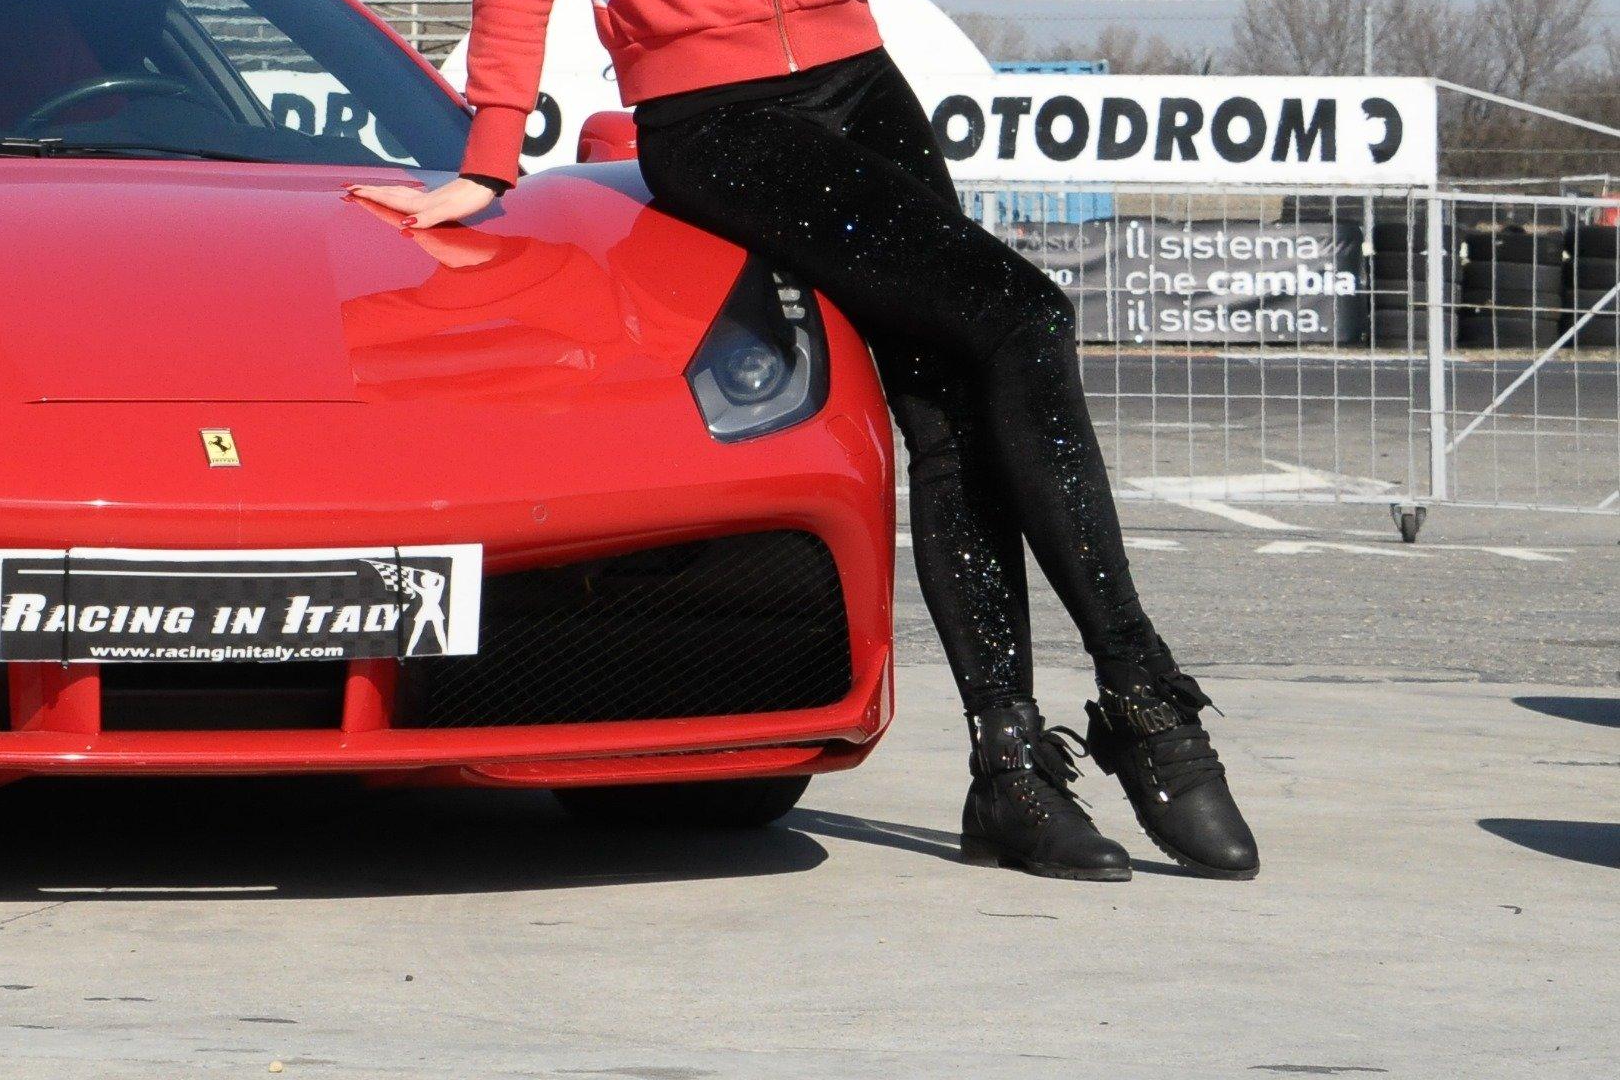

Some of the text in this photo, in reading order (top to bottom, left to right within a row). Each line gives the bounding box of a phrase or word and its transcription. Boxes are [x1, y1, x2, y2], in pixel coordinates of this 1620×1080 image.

[1159, 227, 1319, 260] sistema
[1125, 263, 1356, 296] che cambia
[1127, 300, 1329, 333] il sistema.
[89, 645, 344, 662] www.racinginitaly.com
